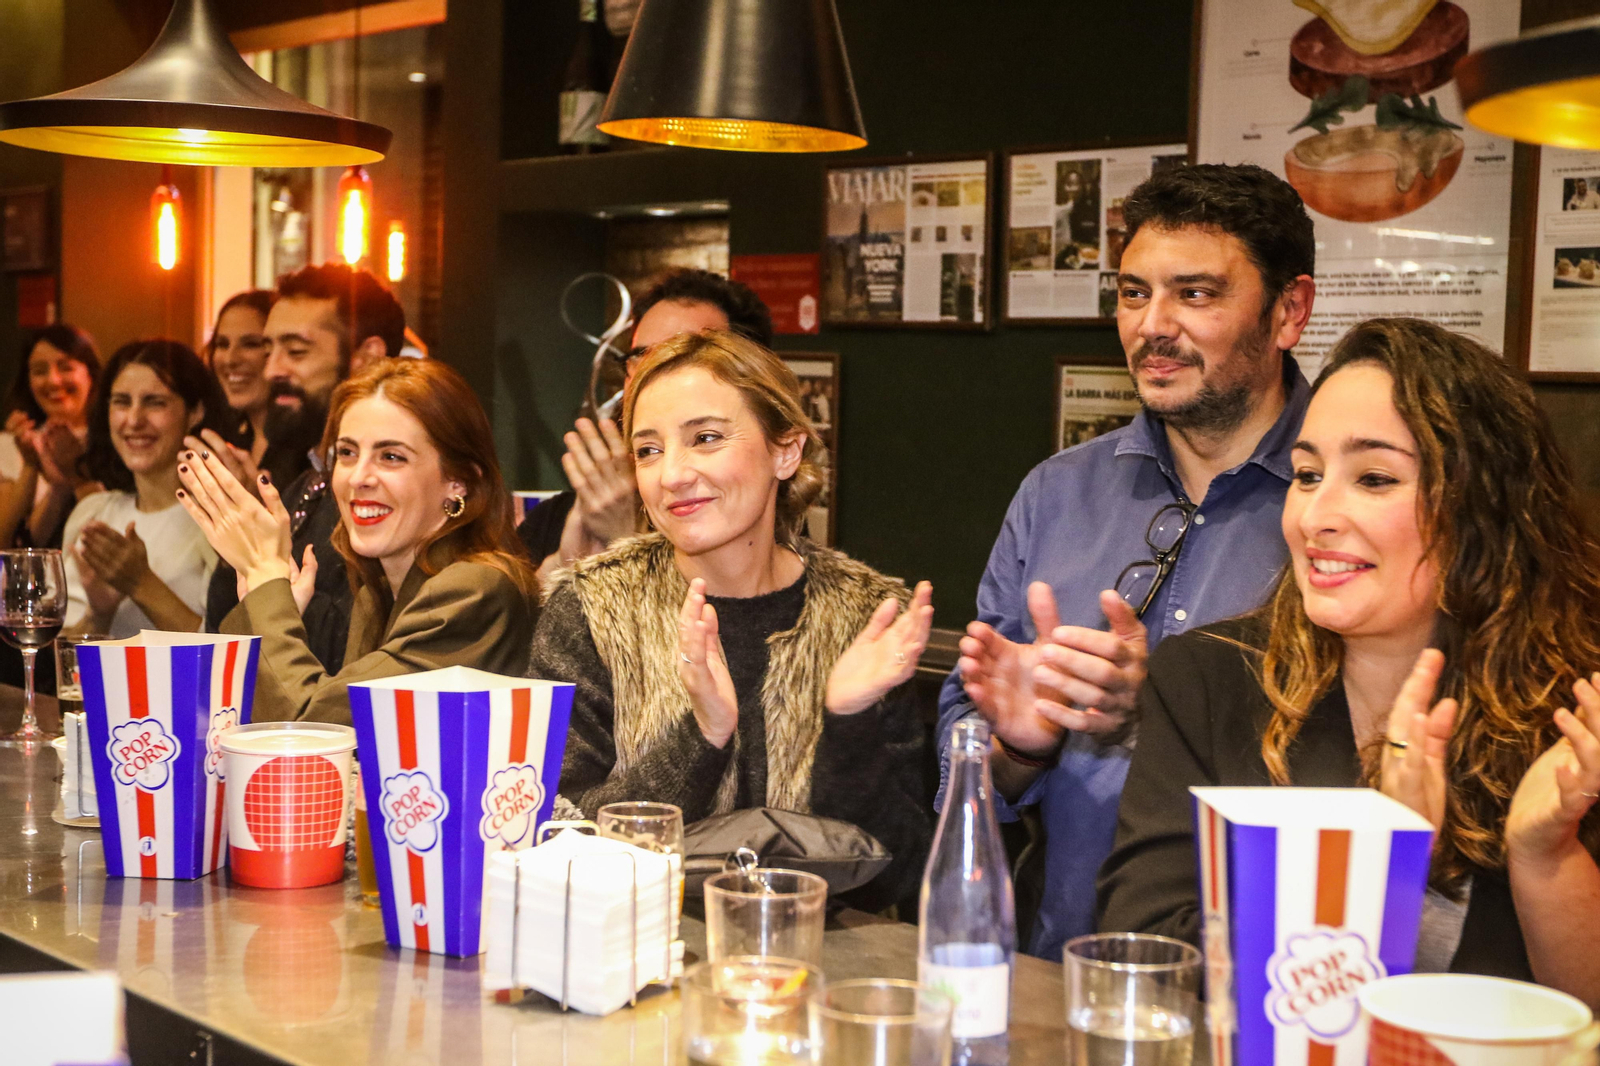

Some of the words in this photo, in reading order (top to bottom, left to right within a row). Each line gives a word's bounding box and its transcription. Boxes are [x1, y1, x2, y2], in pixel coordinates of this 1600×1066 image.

[828, 170, 904, 204] VIAJAR
[860, 243, 902, 257] NUEVA
[865, 259, 898, 272] YORK
[119, 731, 151, 762] POP
[123, 740, 169, 777] CORN
[391, 785, 421, 818] POP
[491, 788, 536, 831] CORN
[494, 778, 526, 811] POP
[395, 796, 437, 836] CORN
[1290, 951, 1346, 988] POP
[1288, 966, 1366, 1014] CORN
